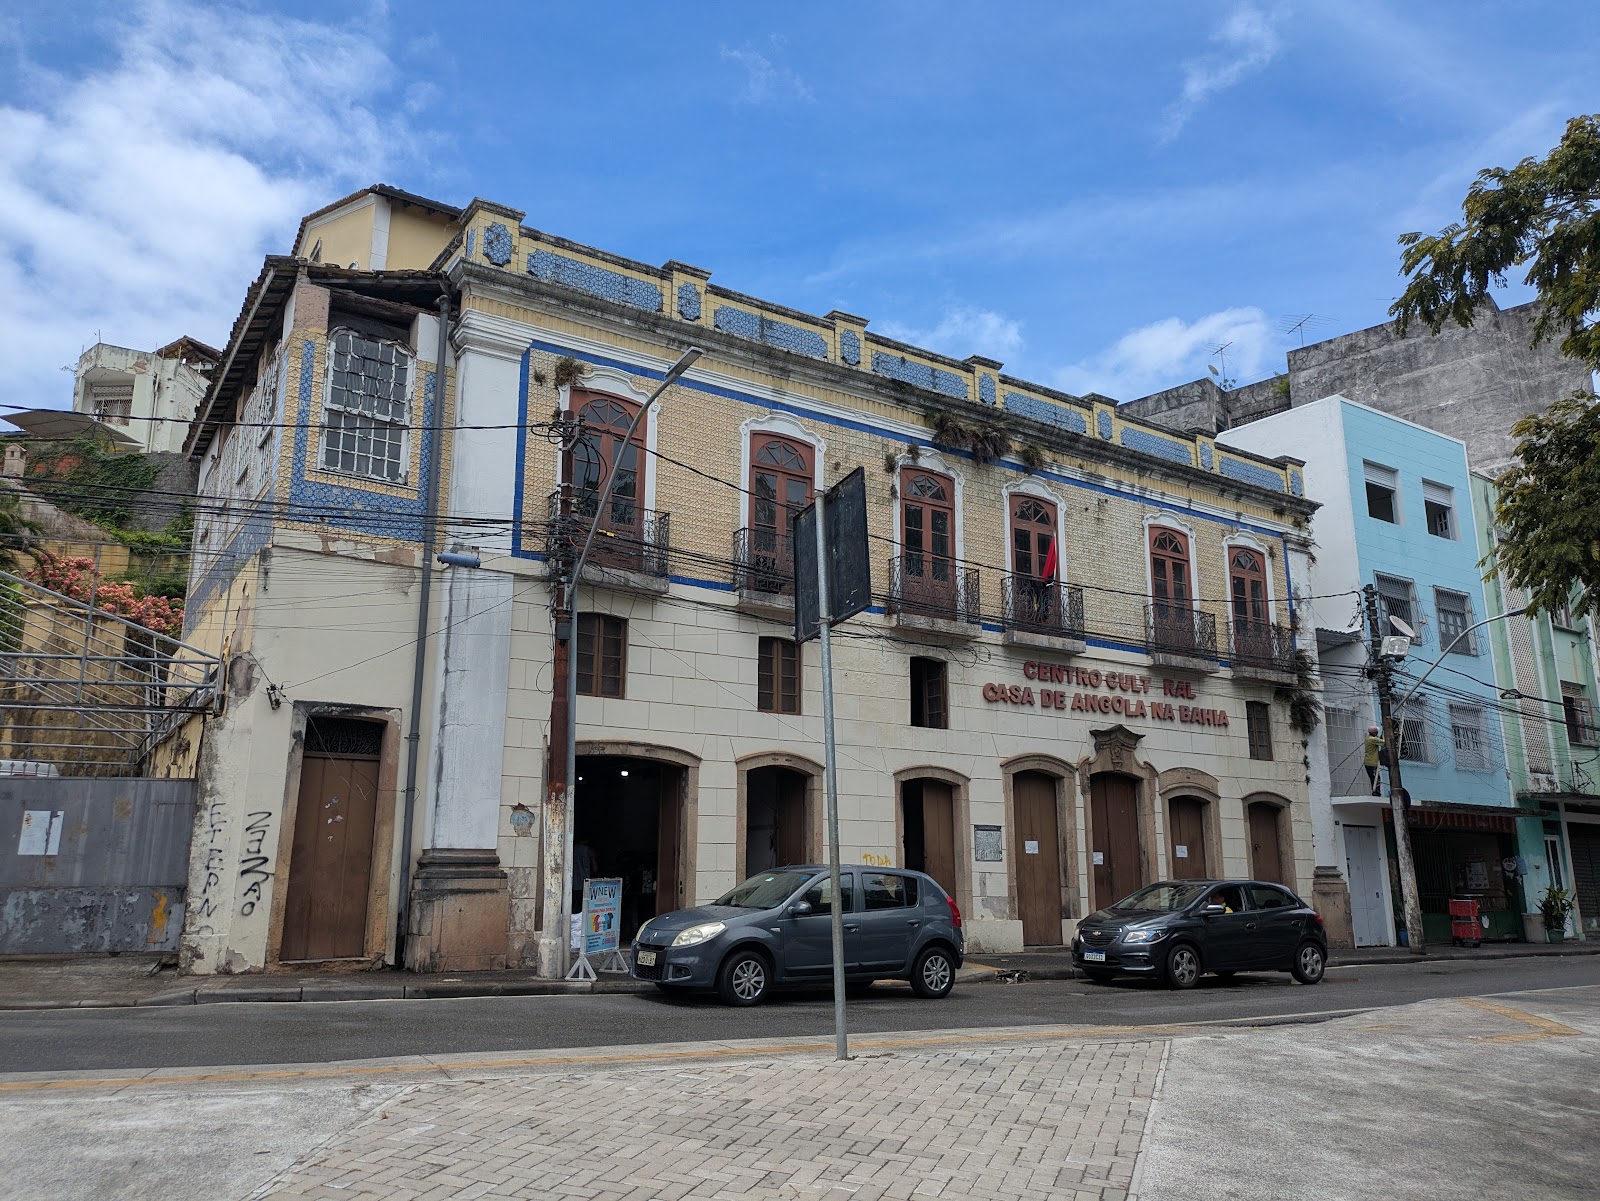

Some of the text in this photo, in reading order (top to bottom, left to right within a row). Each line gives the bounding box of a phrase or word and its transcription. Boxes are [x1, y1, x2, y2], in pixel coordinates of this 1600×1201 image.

[1023, 661, 1103, 688] CENTRO
[983, 683, 1230, 727] CASA DE ANGOLA NA BAHIA
